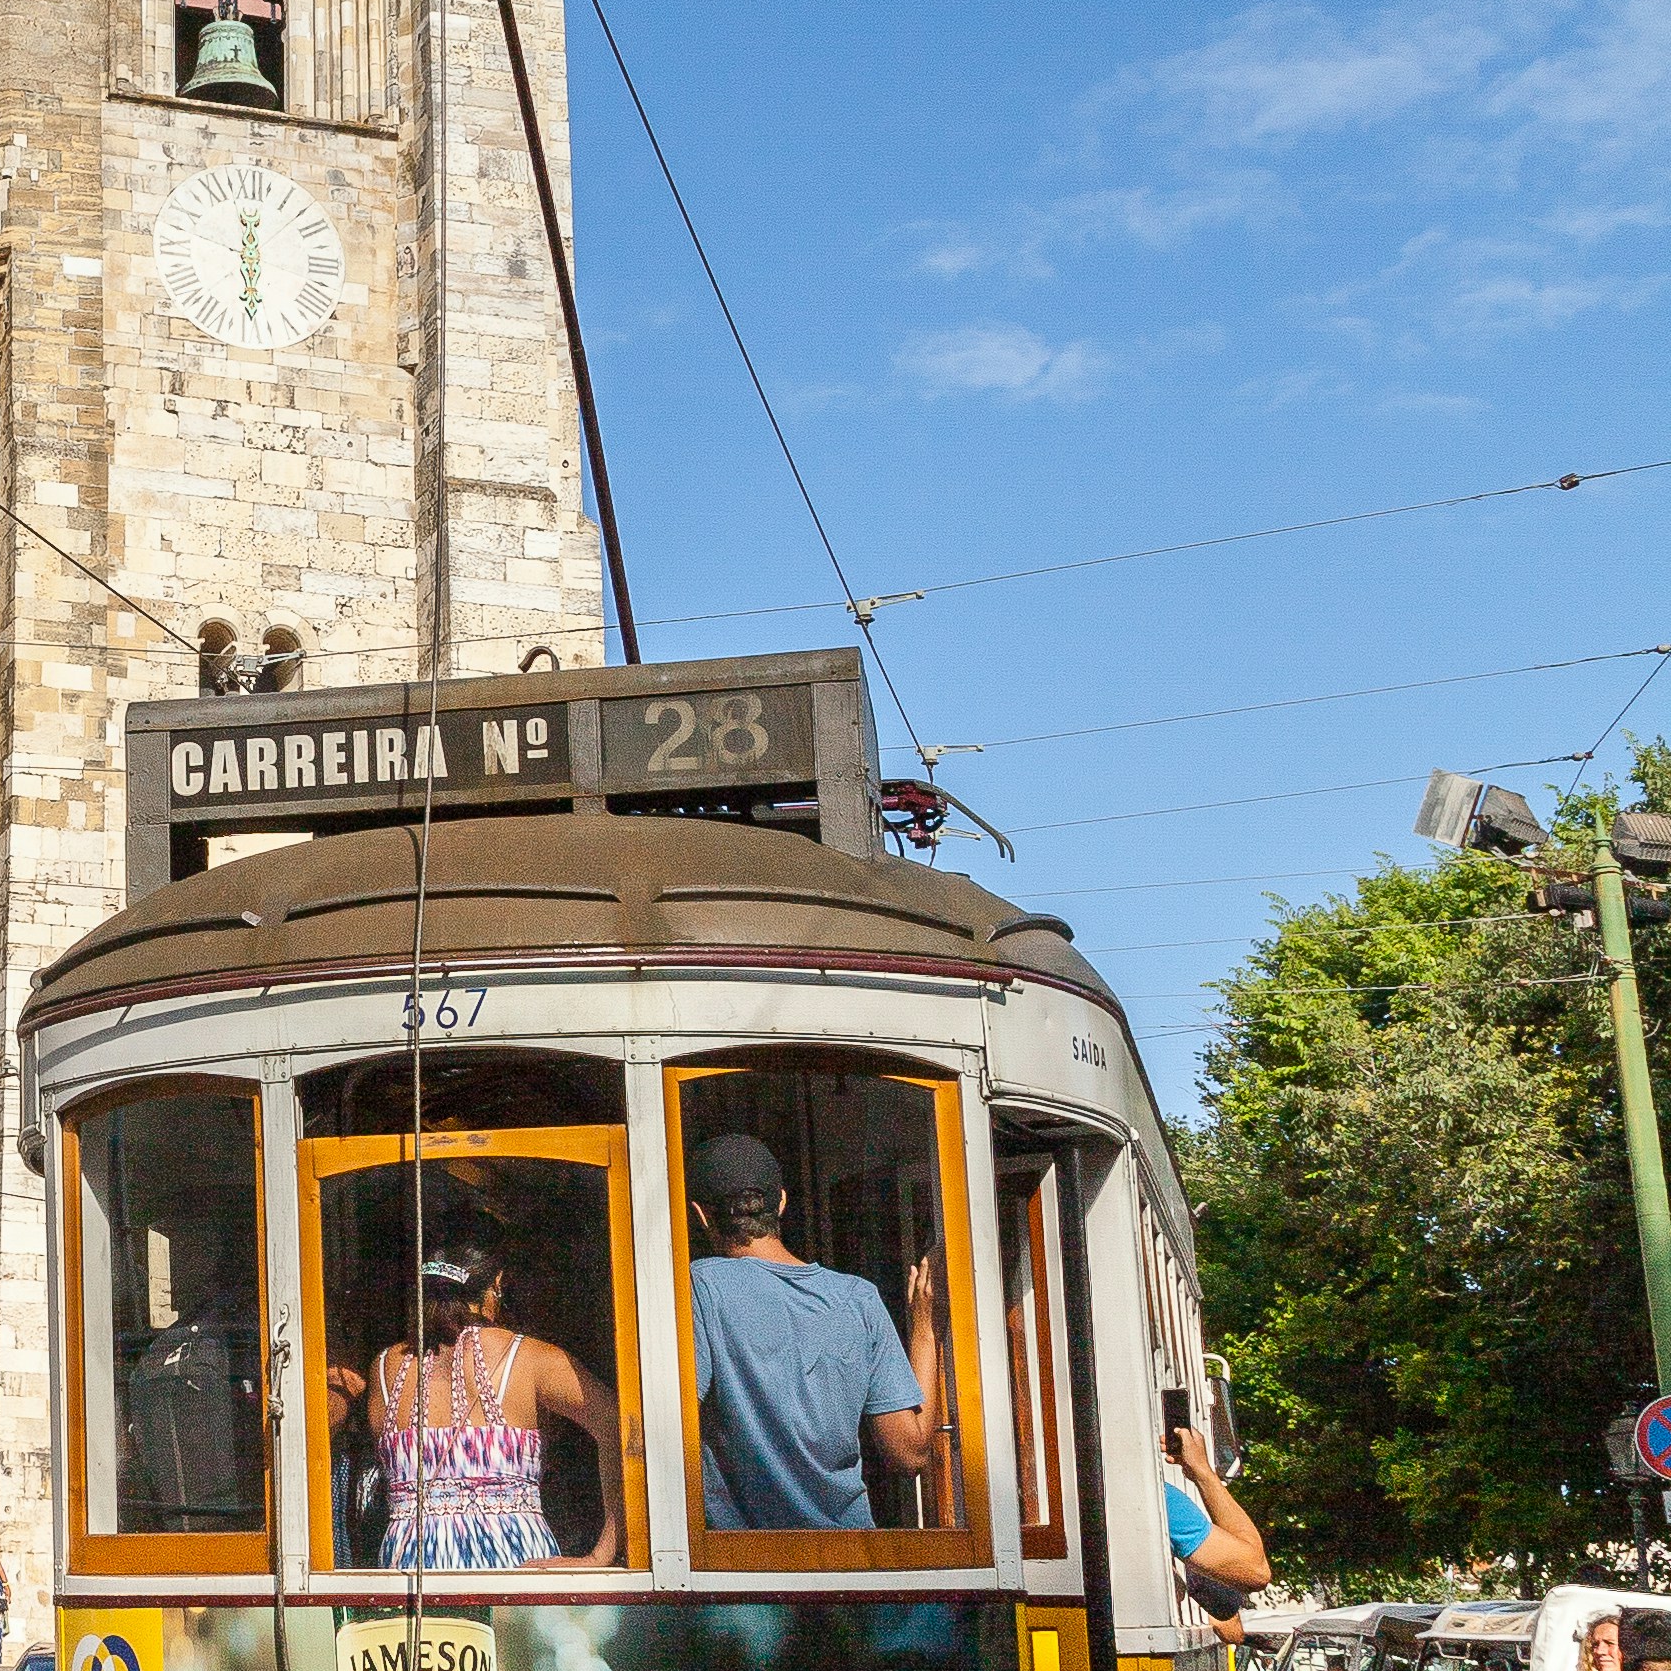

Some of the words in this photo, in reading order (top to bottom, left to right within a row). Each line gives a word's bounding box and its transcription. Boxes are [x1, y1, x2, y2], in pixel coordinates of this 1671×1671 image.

[236, 168, 263, 202] XII
[308, 255, 339, 277] III
[644, 692, 769, 772] 28
[172, 725, 448, 797] CARREIRA
[482, 717, 548, 775] Nº
[402, 988, 487, 1030] 567
[1072, 1032, 1107, 1071] SAÍDA
